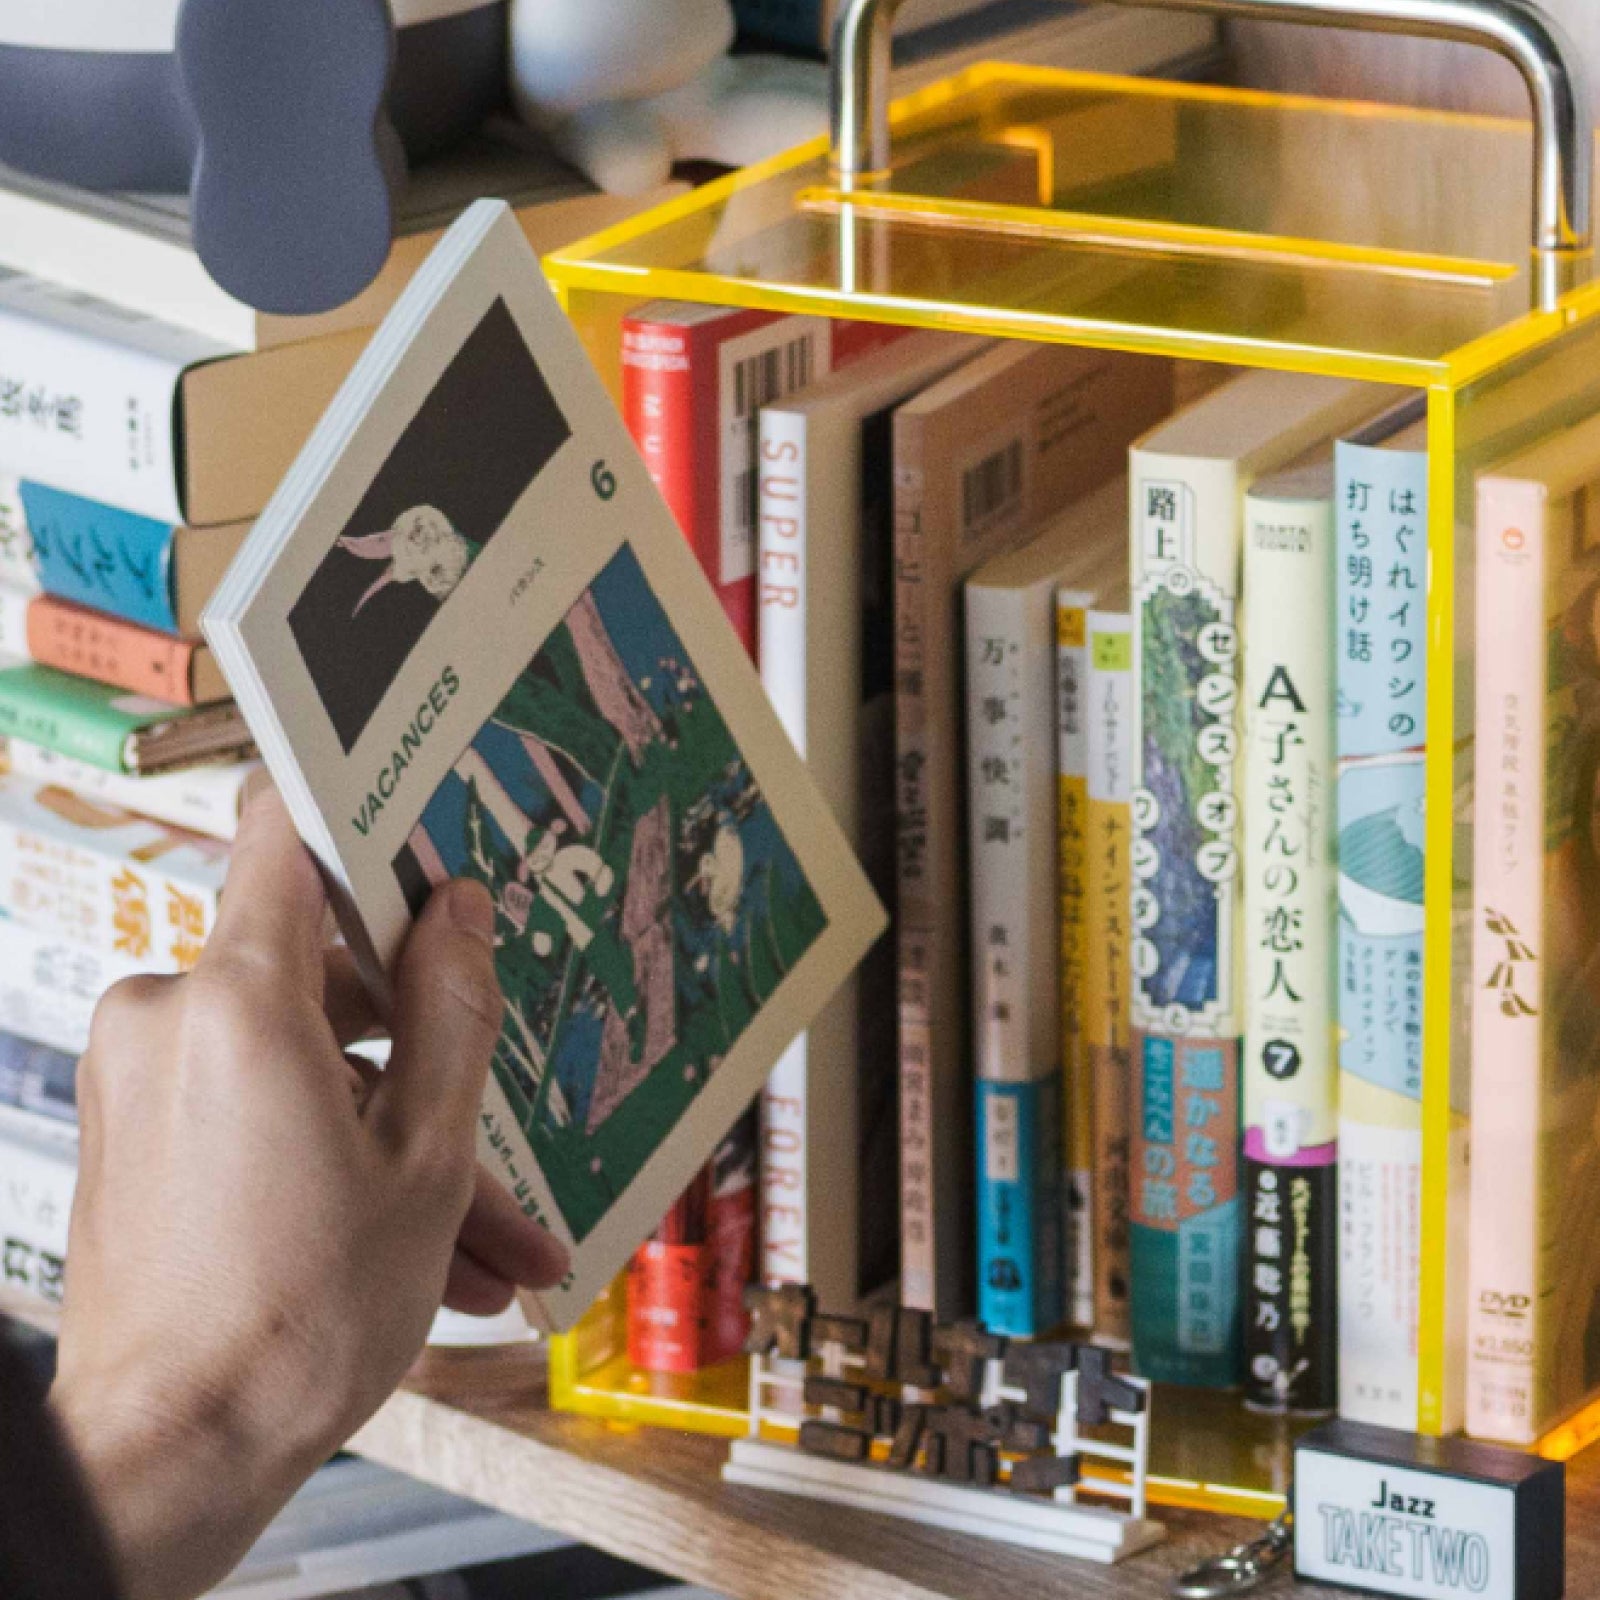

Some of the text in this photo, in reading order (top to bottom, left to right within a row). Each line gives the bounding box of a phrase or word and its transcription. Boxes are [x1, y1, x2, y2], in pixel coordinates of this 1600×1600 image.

[591, 459, 617, 500] 6
[763, 439, 798, 608] SUPER
[1347, 479, 1373, 662] 打ち明け話
[1387, 488, 1417, 737] はぐれイワシの
[352, 665, 460, 837] VACANCES
[1257, 664, 1308, 1002] A子さんの恋人
[764, 1097, 799, 1286] FOREV
[1371, 1479, 1436, 1519] Jazz
